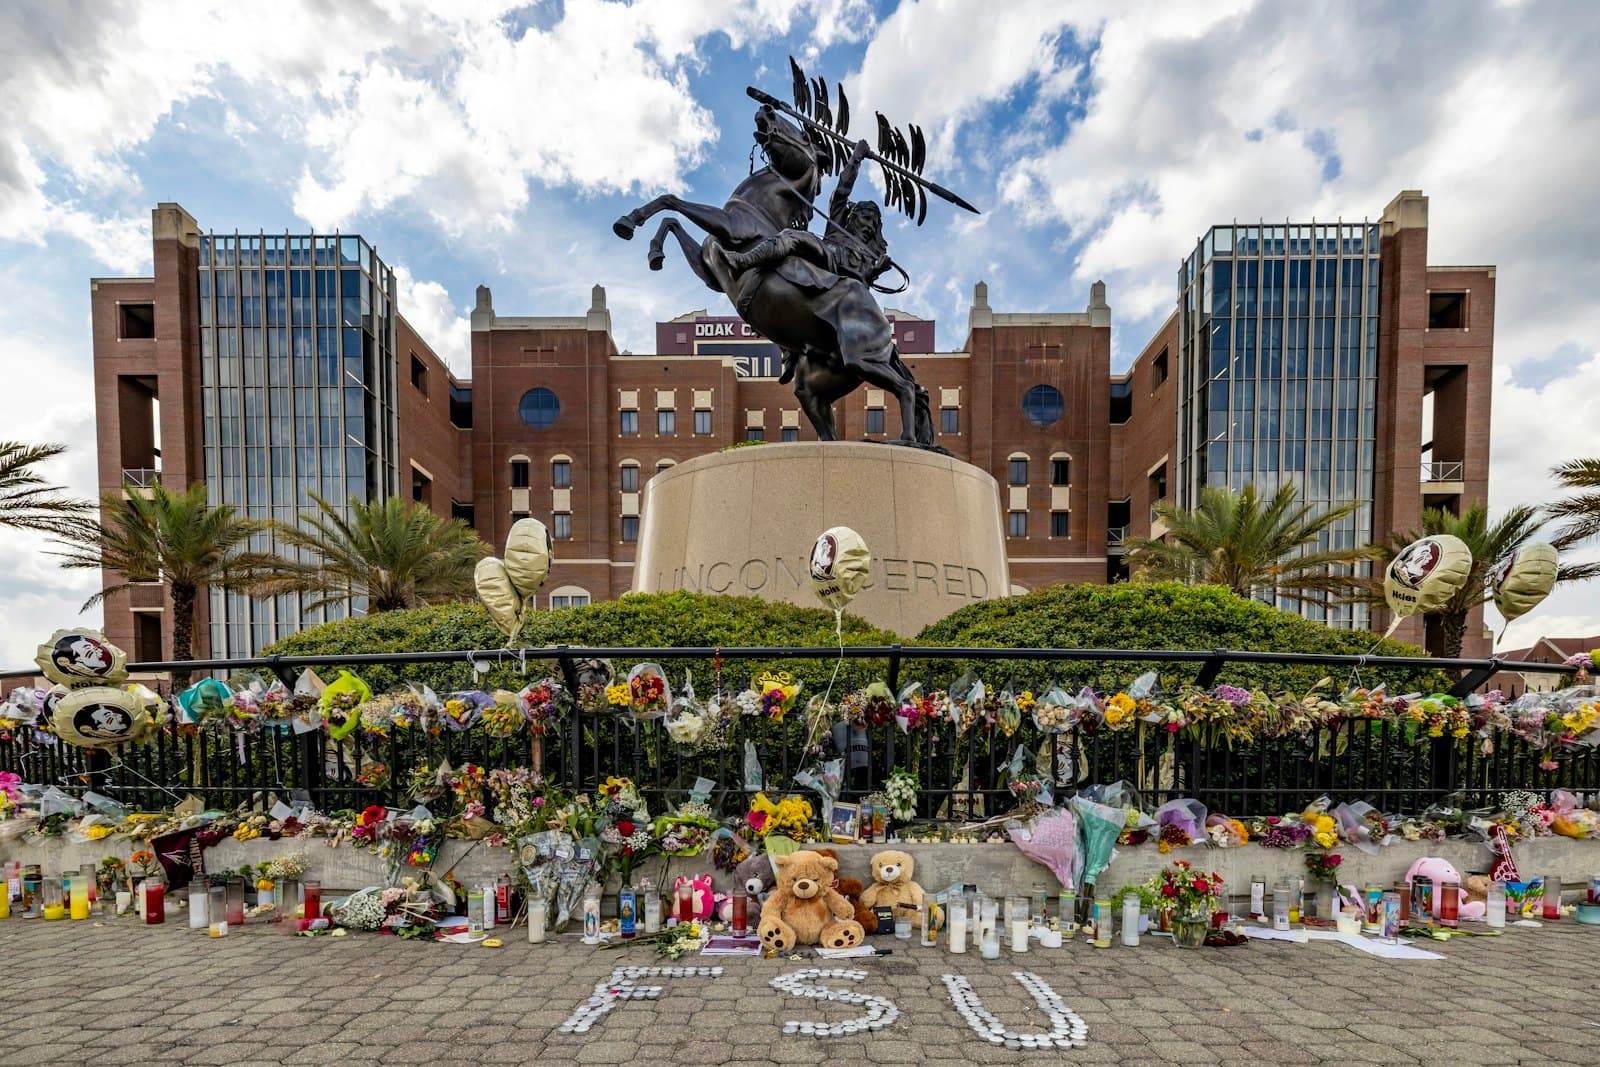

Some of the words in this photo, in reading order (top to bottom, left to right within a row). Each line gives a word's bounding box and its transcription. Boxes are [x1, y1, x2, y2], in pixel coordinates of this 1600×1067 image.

[695, 322, 735, 337] DOAK
[733, 357, 771, 376] SU
[657, 556, 990, 600] UNCONUERED
[1392, 590, 1417, 602] Noles
[557, 965, 1089, 1051] FSU
